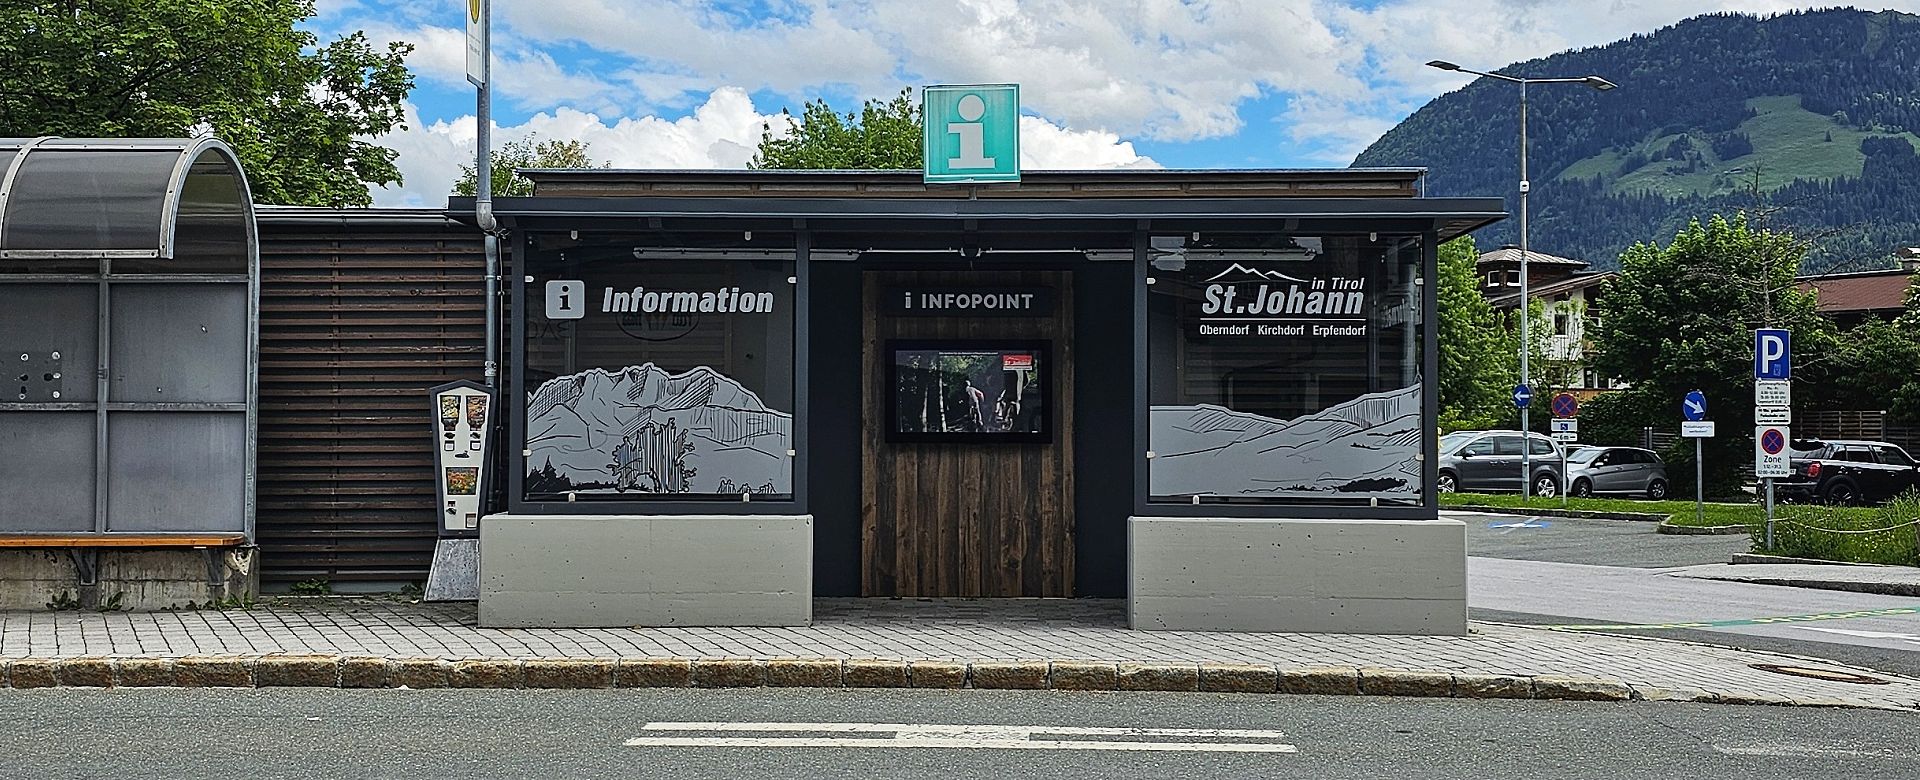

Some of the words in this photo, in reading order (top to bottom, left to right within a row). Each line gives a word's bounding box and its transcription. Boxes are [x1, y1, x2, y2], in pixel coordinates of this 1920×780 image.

[1311, 277, 1326, 290] in
[1331, 276, 1365, 290] Tirol
[602, 286, 775, 314] Information
[921, 293, 1034, 309] INFOPOINT
[1199, 324, 1250, 336] Oberndorf
[1257, 324, 1305, 336] Kirchdorf
[1312, 324, 1367, 338] Erpfendorf
[1762, 335, 1784, 374] P
[1763, 455, 1782, 464] Zone
